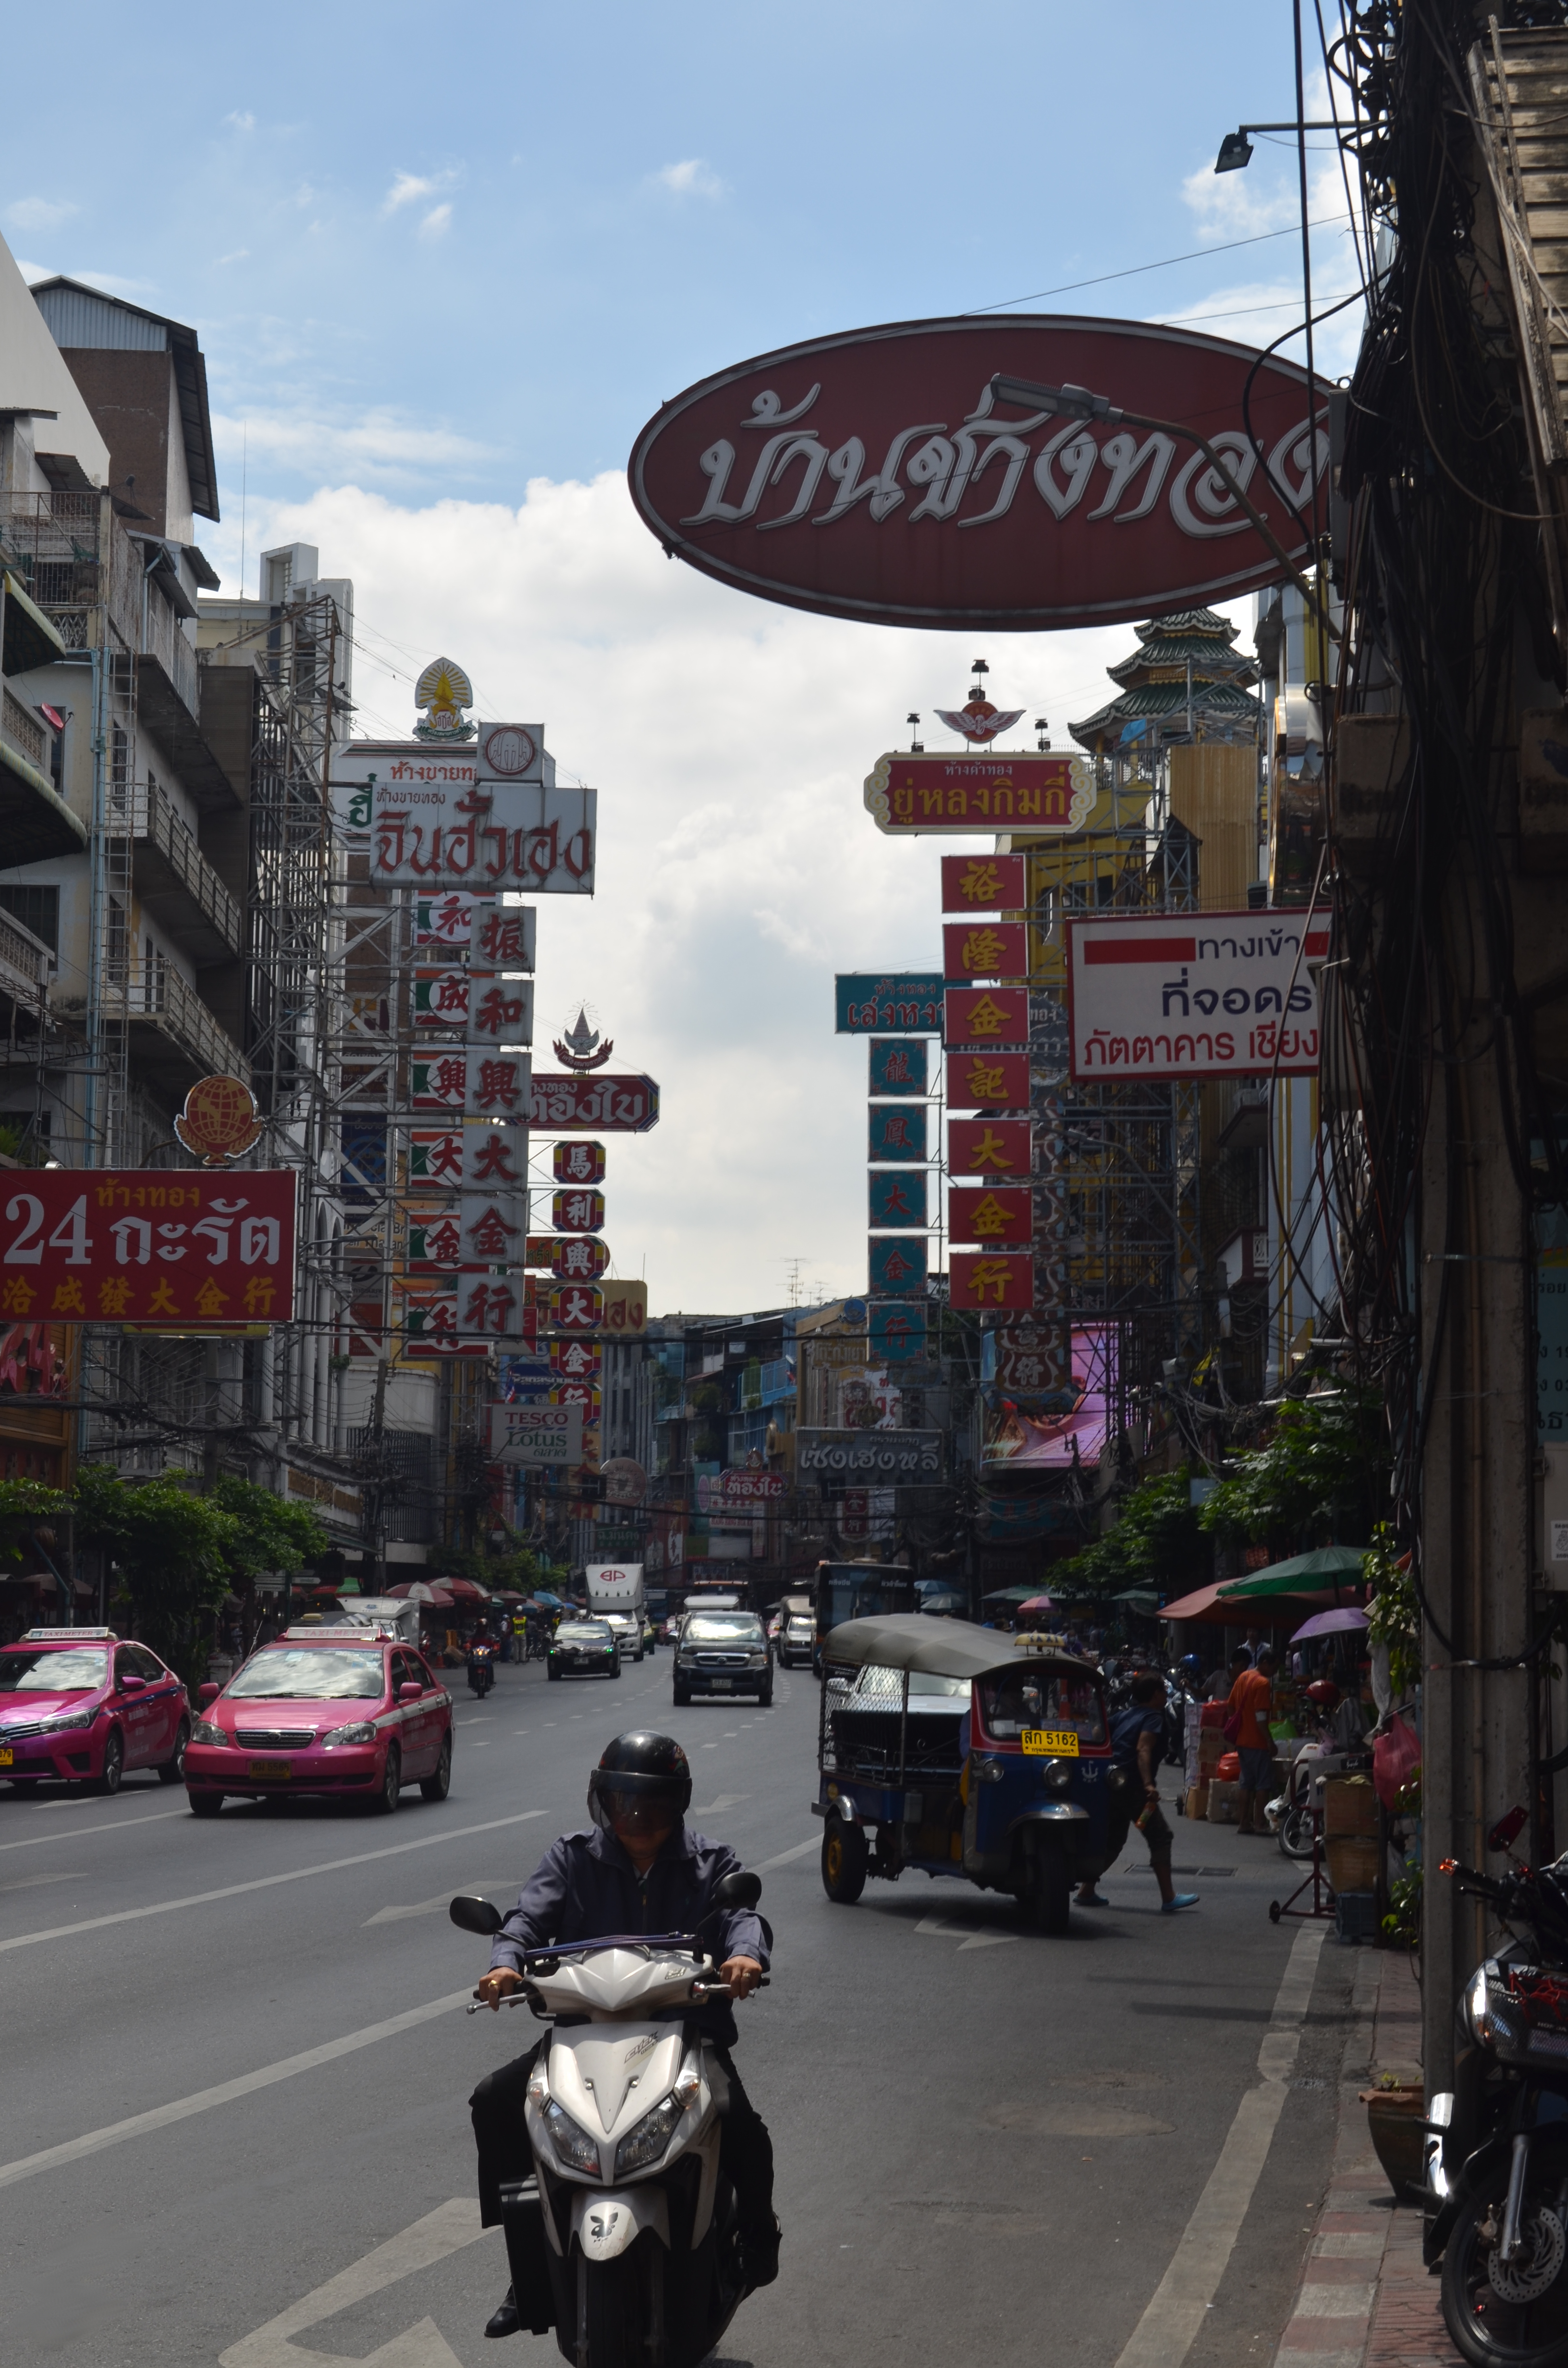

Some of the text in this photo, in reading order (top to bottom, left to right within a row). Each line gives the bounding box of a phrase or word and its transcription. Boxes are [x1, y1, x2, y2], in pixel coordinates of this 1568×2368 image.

[679, 381, 1330, 538] บ้านช่างทอง
[391, 761, 477, 780] ห้างขายท
[944, 761, 1013, 776] ห้างค้าทอง
[376, 788, 446, 805] ห้างขายทอง
[894, 765, 1066, 825] ยู่หลงกิมกี่
[1199, 928, 1301, 960] ทางเข้า
[874, 978, 936, 995] ห้างทอง
[1163, 968, 1313, 1017] ที่จอดร
[847, 997, 944, 1027] เล่งหง
[1084, 1029, 1235, 1066] ภัตตาคาร
[531, 1083, 578, 1094] างทอง
[959, 860, 1016, 1304] 裕隆金記大金行
[465, 913, 527, 1333] 振和興大金行
[95, 1177, 201, 1208] ห้างทอง
[882, 1050, 914, 1349] 龍鳳大金行
[4, 1193, 281, 1266] 24 กะรัต
[1538, 1273, 1566, 1294] ร่อย
[504, 1412, 568, 1425] TESCO
[507, 1431, 567, 1447] Lotus
[1027, 1634, 1059, 1643] TAXI
[1024, 1731, 1077, 1747] สก 5162
